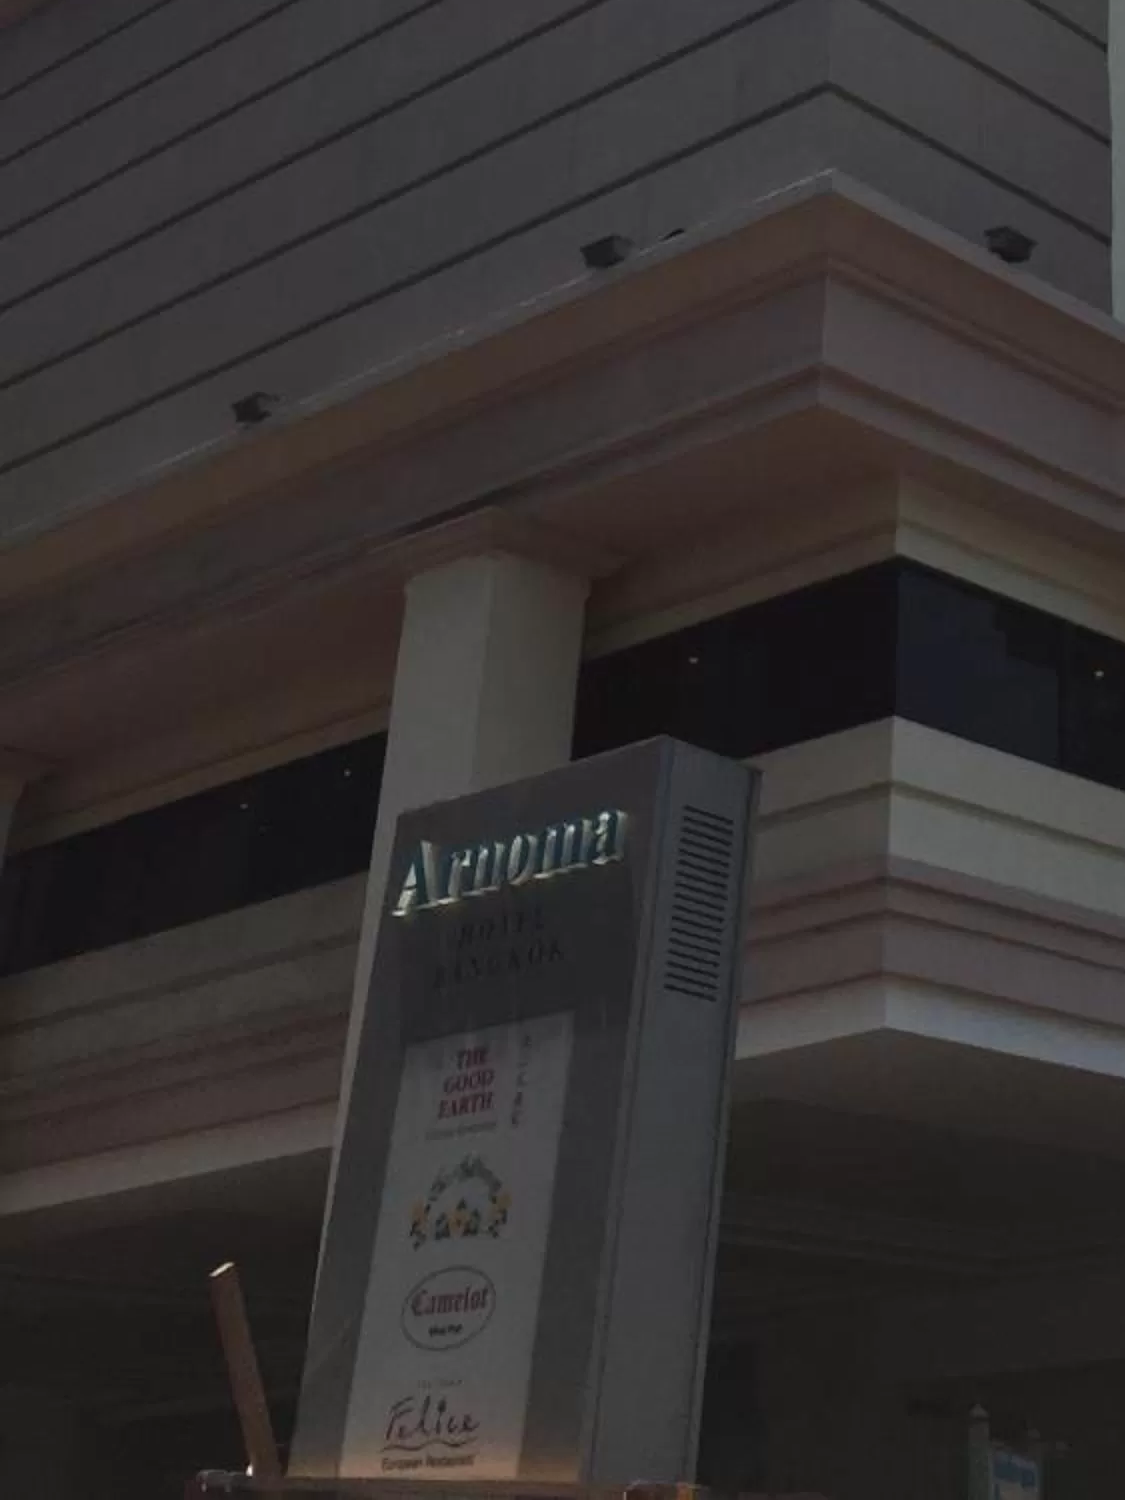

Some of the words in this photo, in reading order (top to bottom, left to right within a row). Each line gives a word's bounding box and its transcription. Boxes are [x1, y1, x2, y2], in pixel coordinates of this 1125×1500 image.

[391, 809, 628, 917] Arnoma
[456, 1046, 489, 1071] THE
[443, 1069, 495, 1095] GOOD
[437, 1092, 495, 1120] EARTH
[410, 1285, 489, 1317] Camelot
